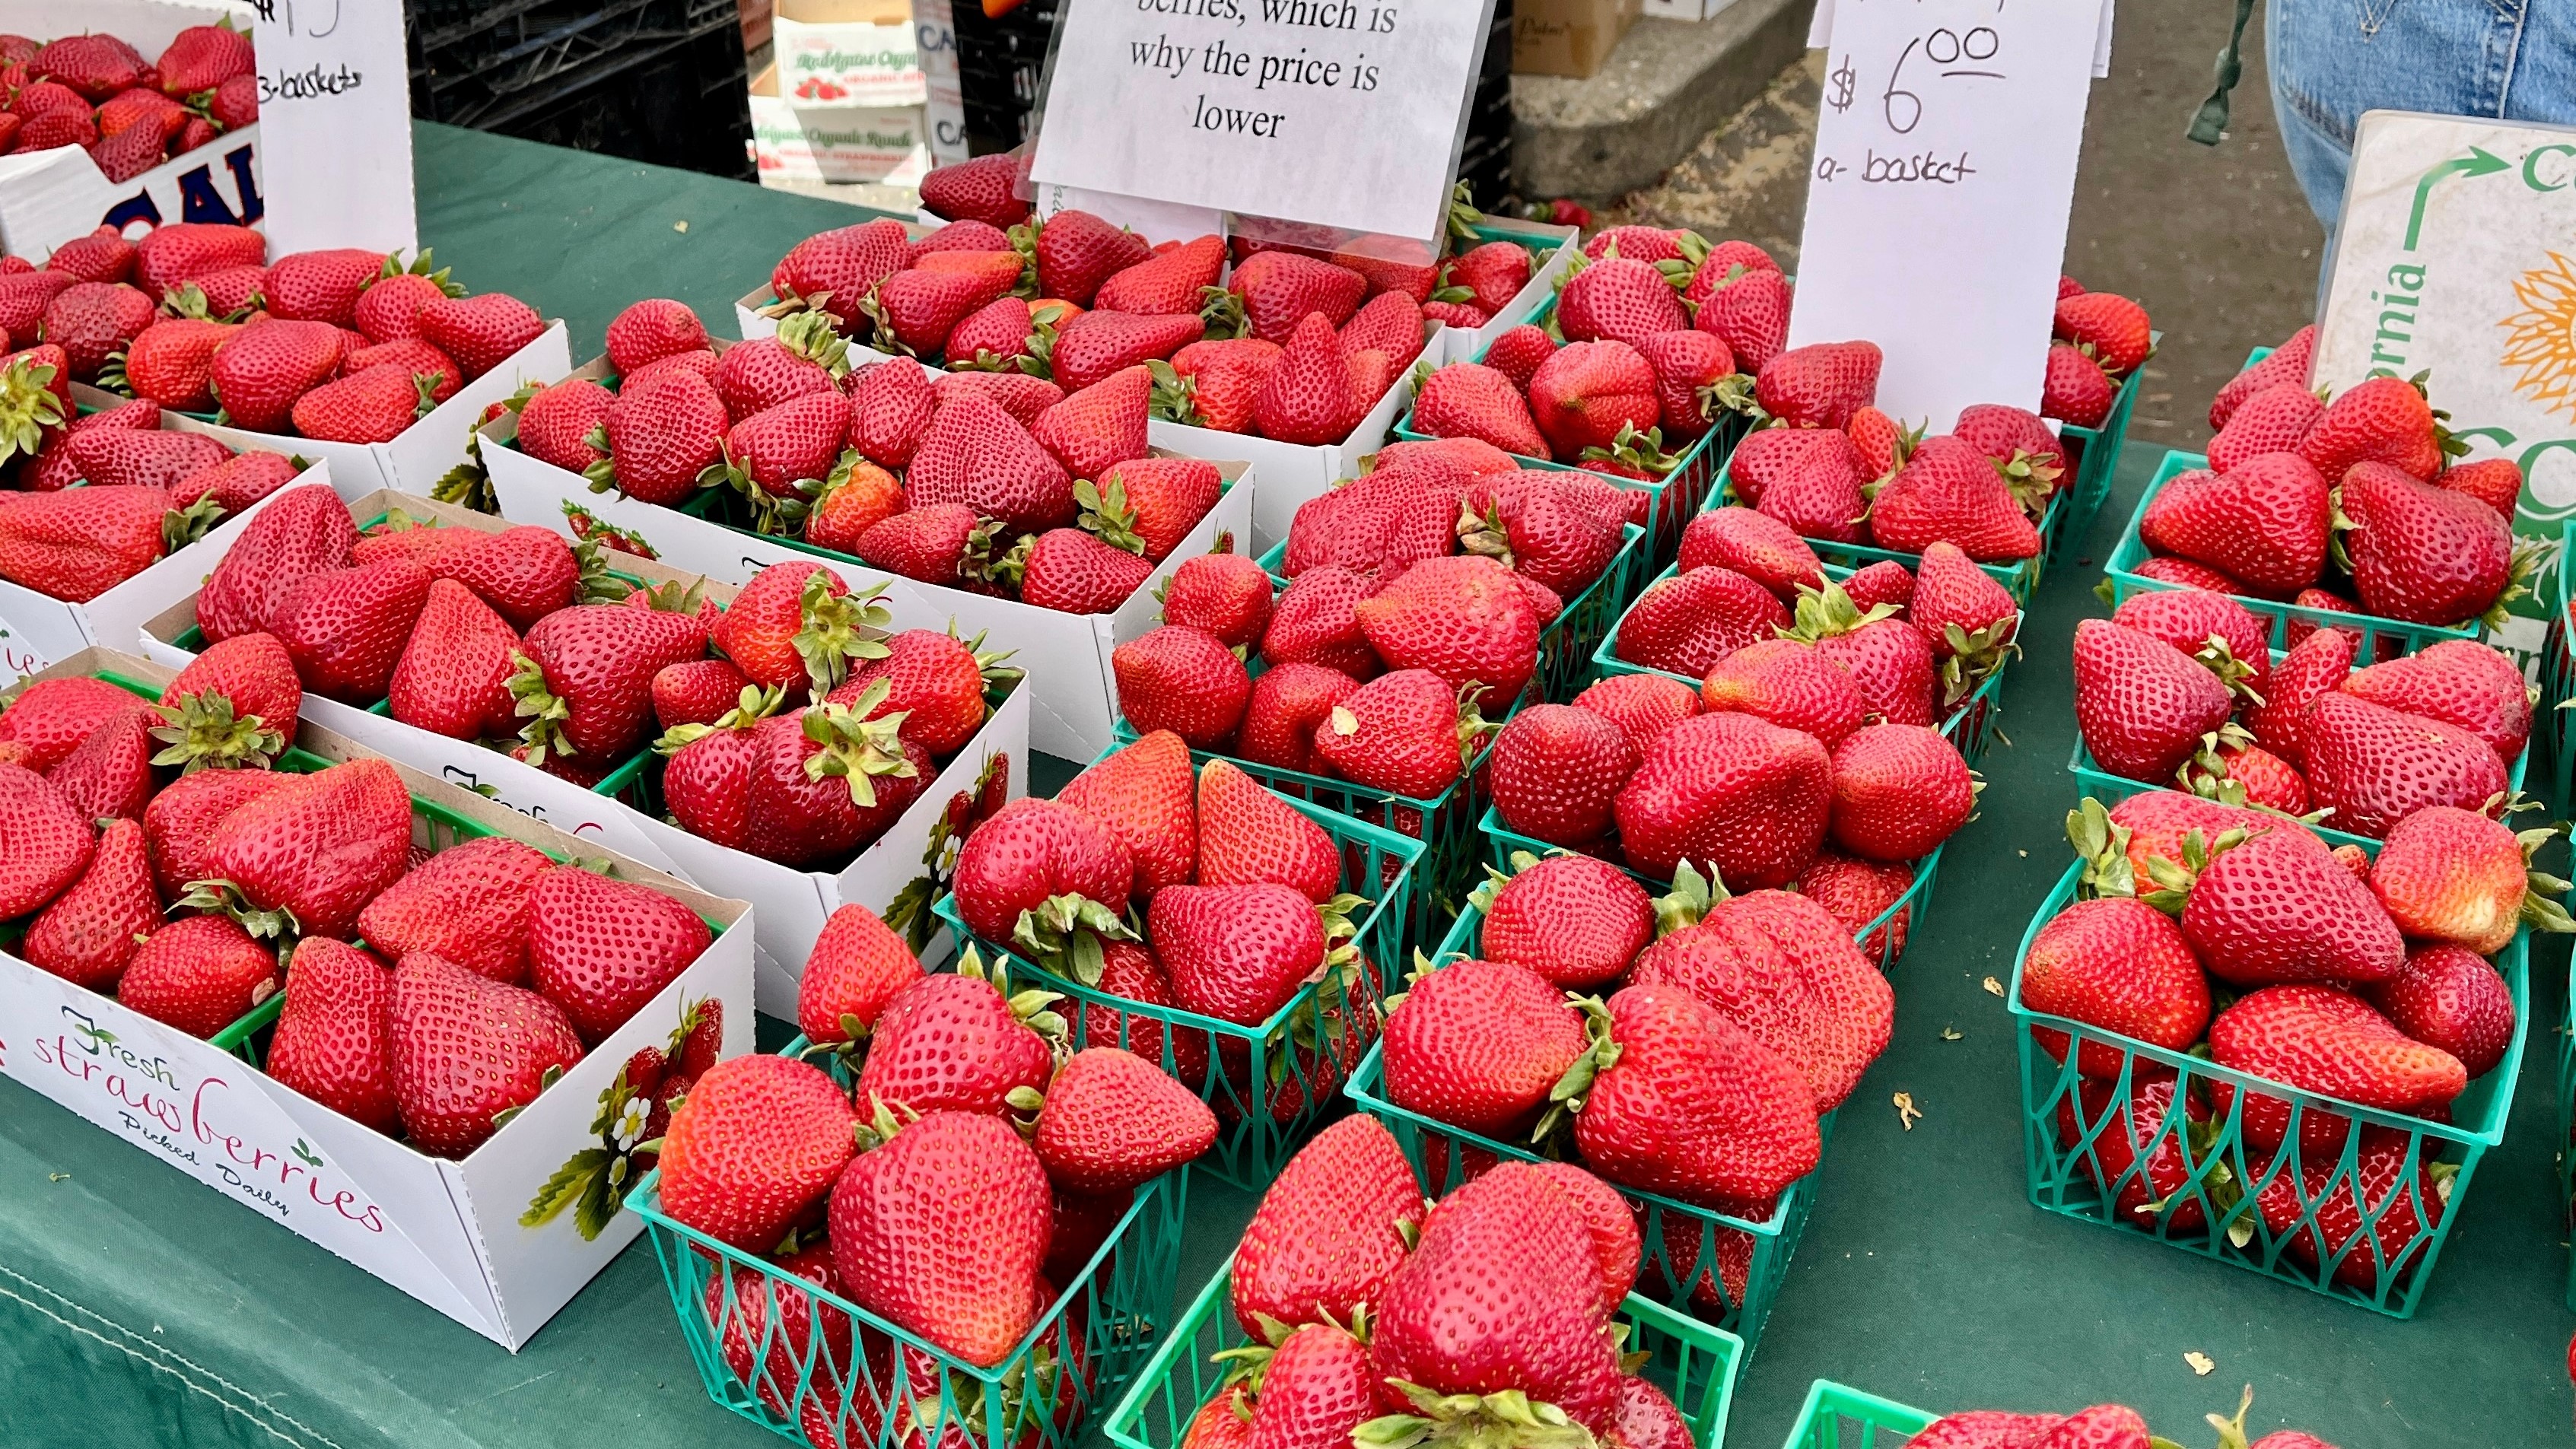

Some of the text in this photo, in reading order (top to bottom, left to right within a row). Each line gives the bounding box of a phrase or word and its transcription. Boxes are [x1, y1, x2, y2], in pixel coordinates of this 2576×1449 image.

[1261, 0, 1356, 30] which
[1367, 0, 1397, 33] is
[1131, 33, 1380, 91] why the price is
[1192, 94, 1285, 138] lower
[1862, 149, 1977, 183] basket
[61, 1005, 181, 1092] Fresh
[33, 1034, 384, 1234] strawberries
[118, 1110, 291, 1217] Picked Daily
